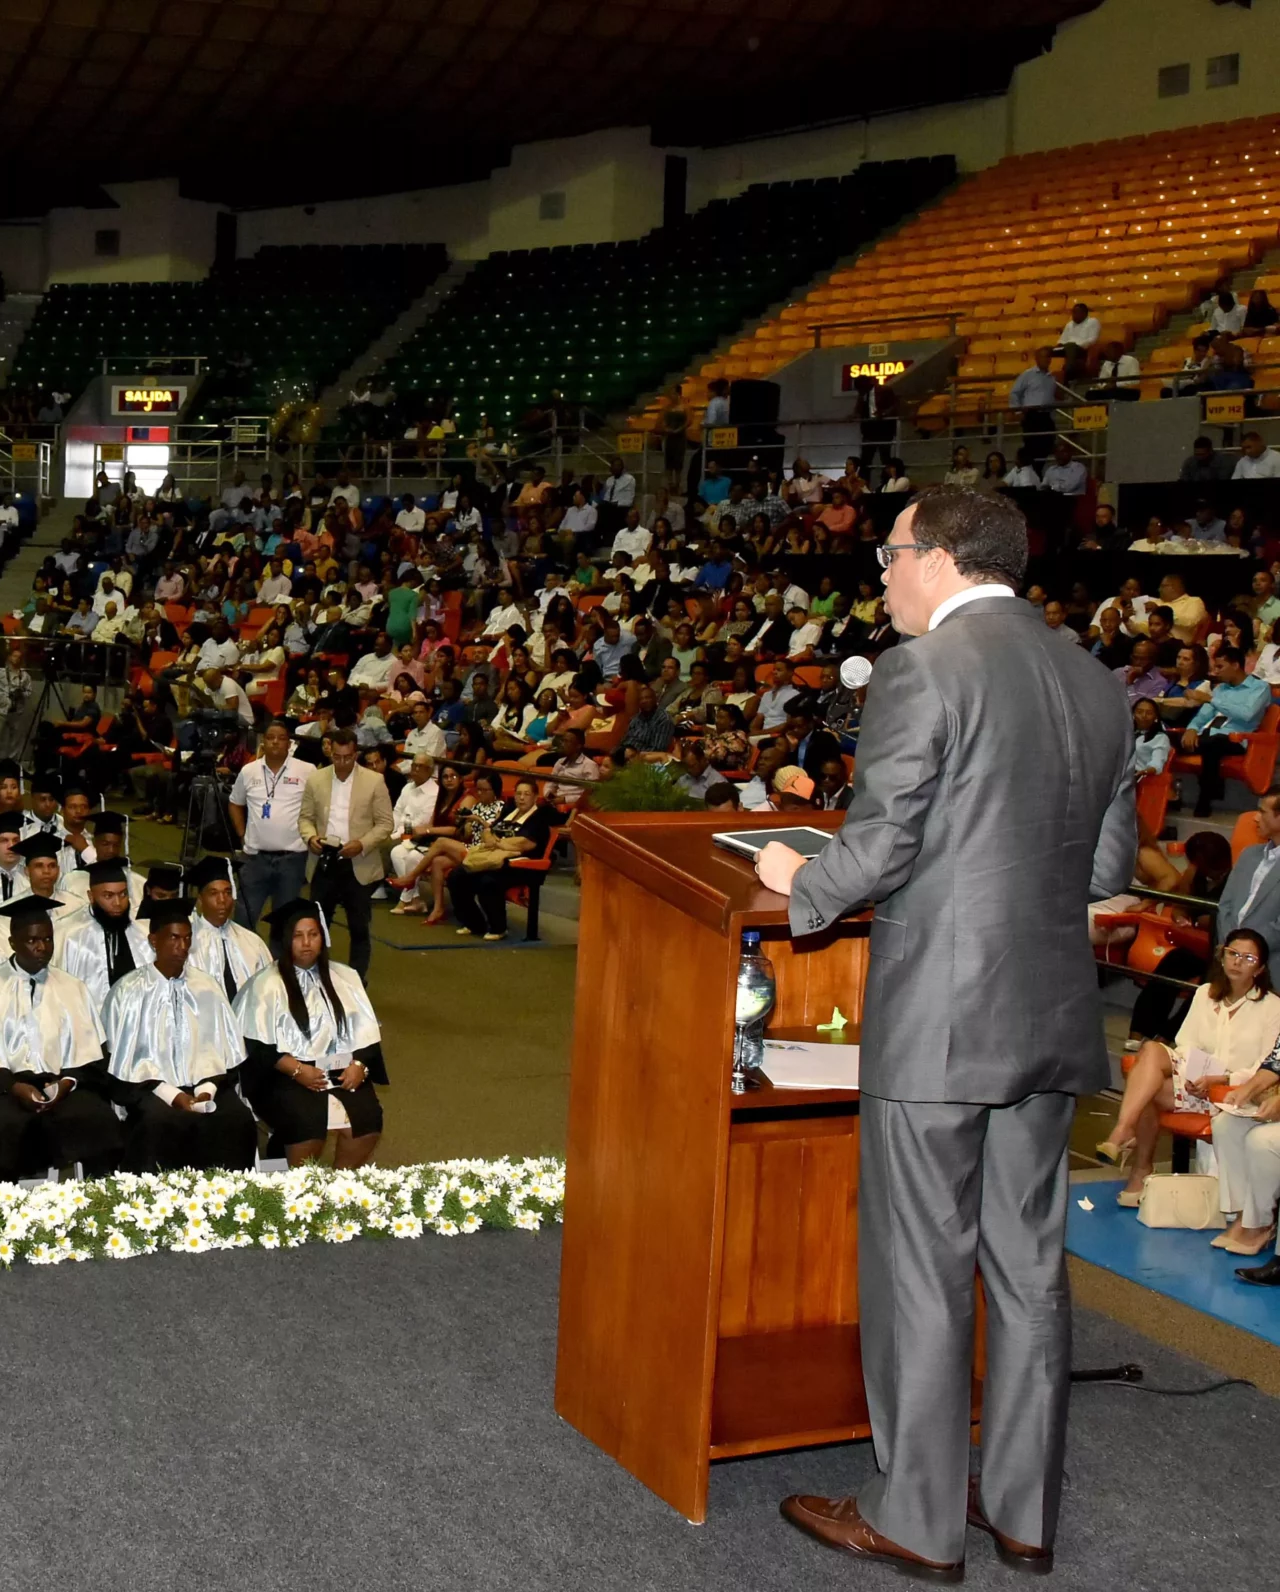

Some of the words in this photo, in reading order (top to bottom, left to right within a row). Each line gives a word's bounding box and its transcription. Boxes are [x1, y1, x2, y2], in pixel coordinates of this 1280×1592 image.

[850, 362, 905, 378] SALIDA
[125, 391, 172, 402] SALIDA
[143, 401, 153, 412] J
[1208, 406, 1225, 414] VIP
